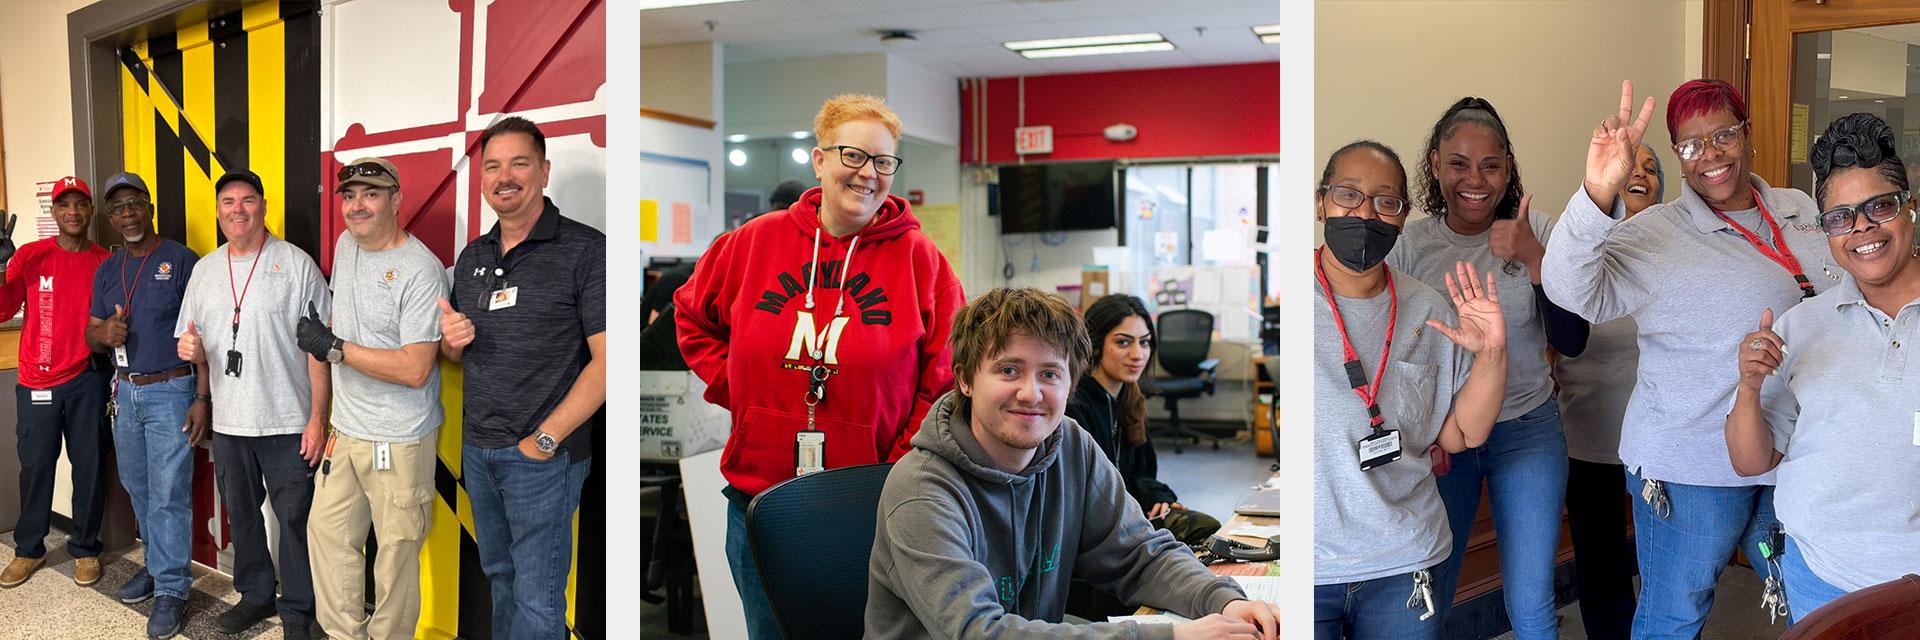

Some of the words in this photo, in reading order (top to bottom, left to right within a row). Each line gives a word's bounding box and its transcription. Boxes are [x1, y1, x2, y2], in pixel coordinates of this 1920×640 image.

[1020, 130, 1046, 149] EXIT
[65, 178, 76, 186] M
[40, 275, 53, 290] M
[755, 260, 892, 326] MARYLAND
[784, 310, 850, 365] M
[640, 414, 669, 424] ATES
